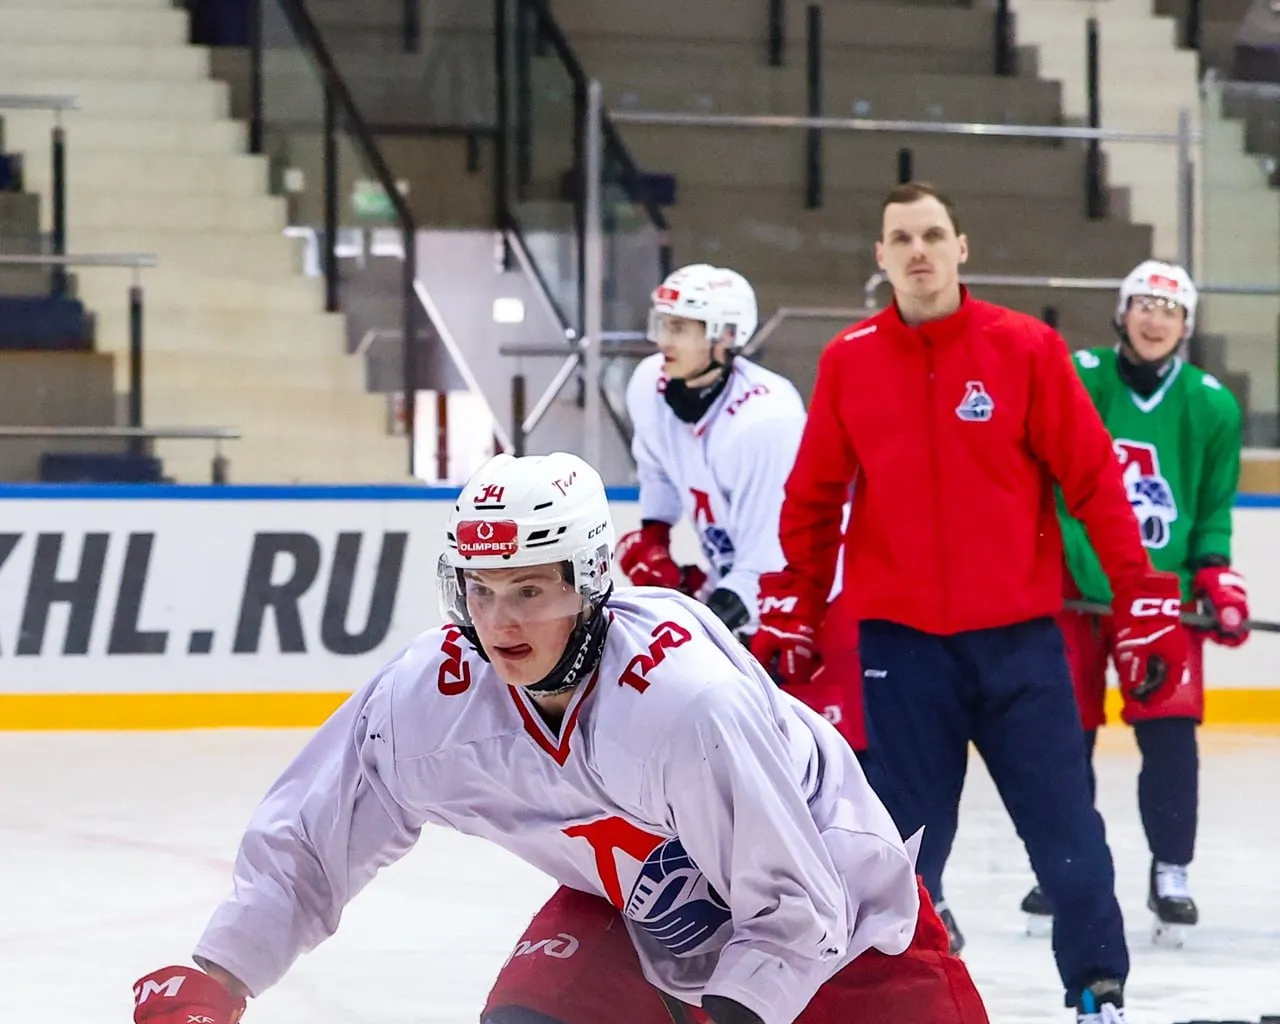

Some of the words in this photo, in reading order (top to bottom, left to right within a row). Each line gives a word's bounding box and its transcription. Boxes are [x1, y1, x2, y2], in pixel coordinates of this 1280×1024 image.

[587, 521, 608, 539] CCM
[460, 541, 514, 551] OLIMPBET
[562, 633, 593, 685] CCM
[186, 1014, 215, 1024] XF
